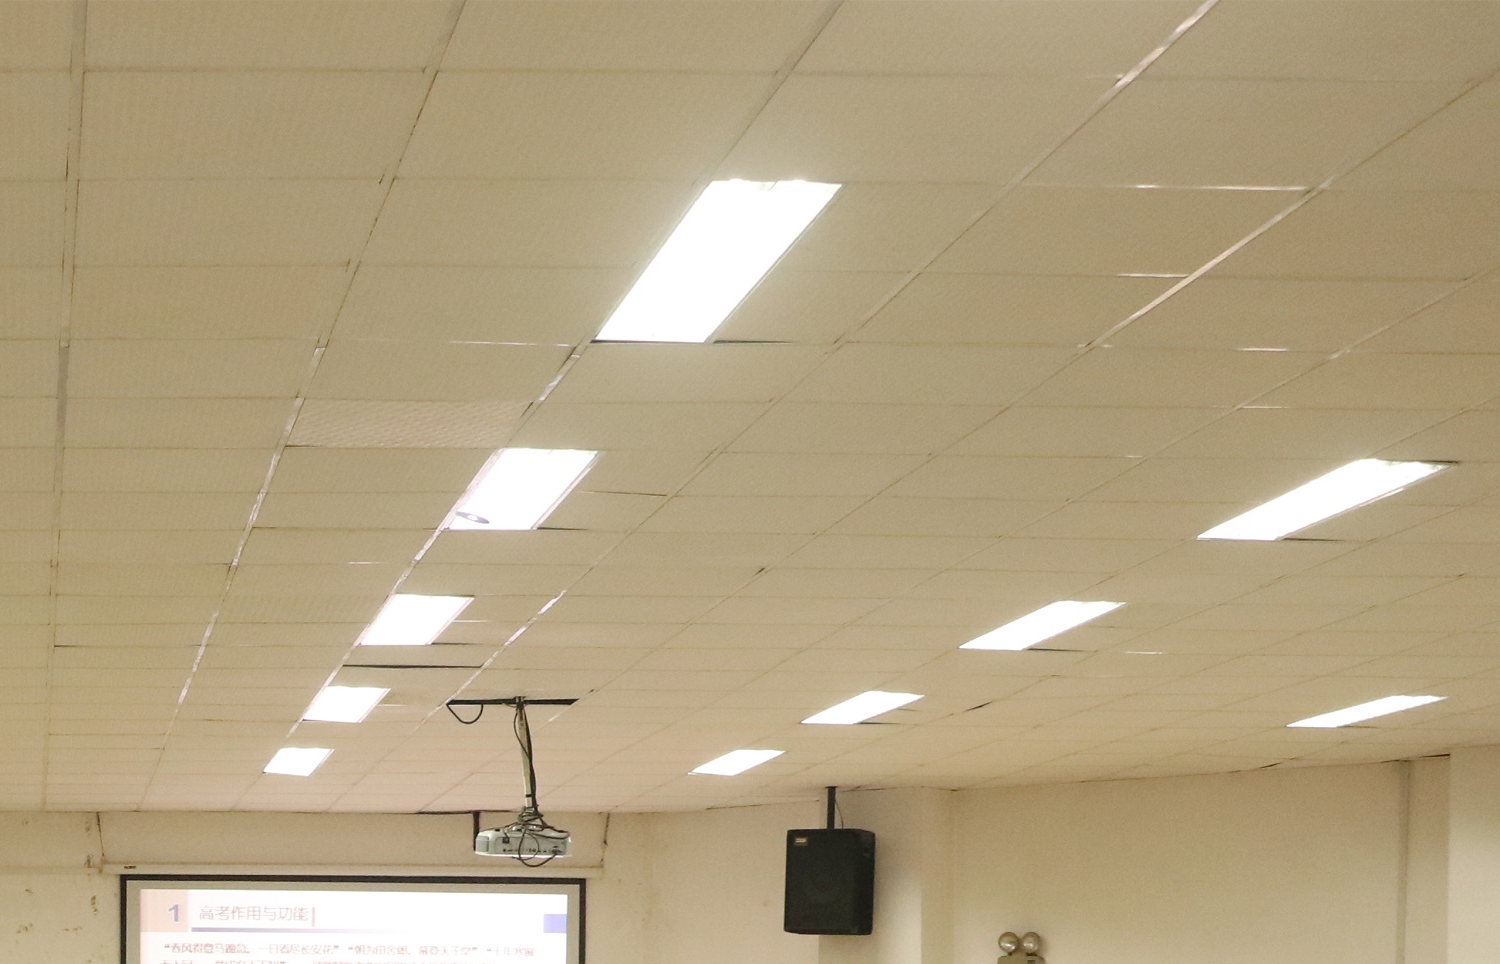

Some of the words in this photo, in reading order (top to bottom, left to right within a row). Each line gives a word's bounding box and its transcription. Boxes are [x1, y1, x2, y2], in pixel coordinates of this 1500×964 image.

[167, 903, 180, 923] 1
[199, 904, 309, 922] 高考作用与功能
